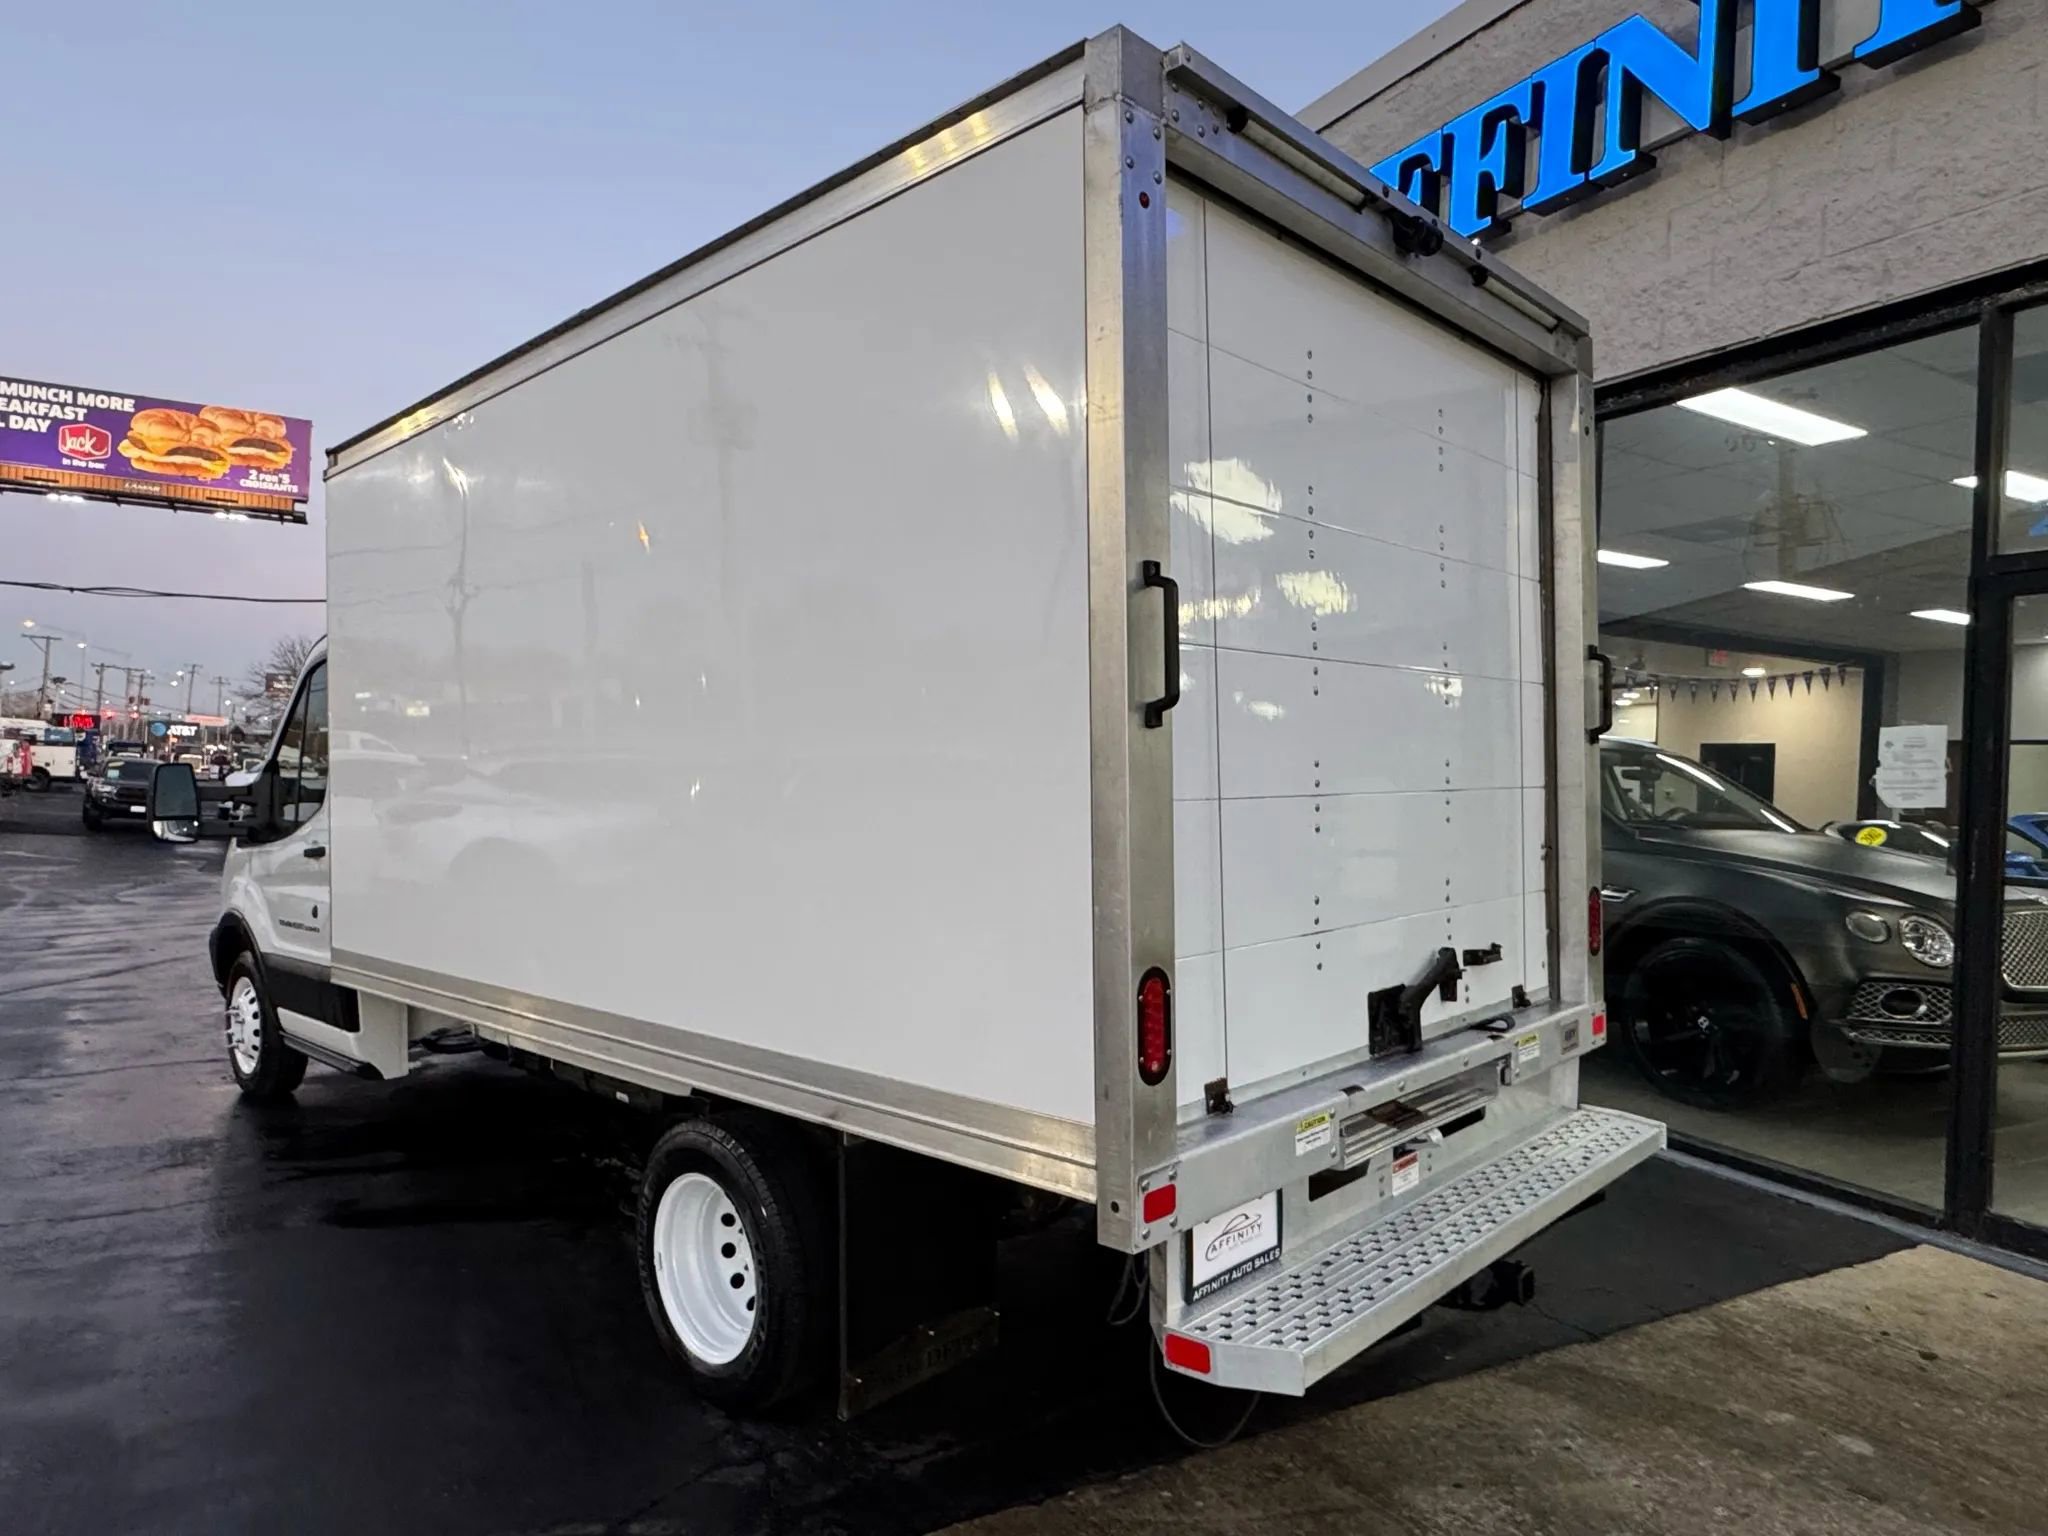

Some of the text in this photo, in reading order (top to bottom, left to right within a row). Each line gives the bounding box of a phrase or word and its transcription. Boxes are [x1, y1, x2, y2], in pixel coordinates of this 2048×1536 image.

[0, 381, 136, 412] MUNCH MORE
[9, 414, 52, 433] DAY
[61, 428, 107, 456] Jack
[249, 470, 258, 480] 2
[167, 725, 198, 736] AT&T
[1211, 1222, 1263, 1254] AFFINITY
[1192, 1248, 1281, 1301] AFFINITY AUTO SALES
